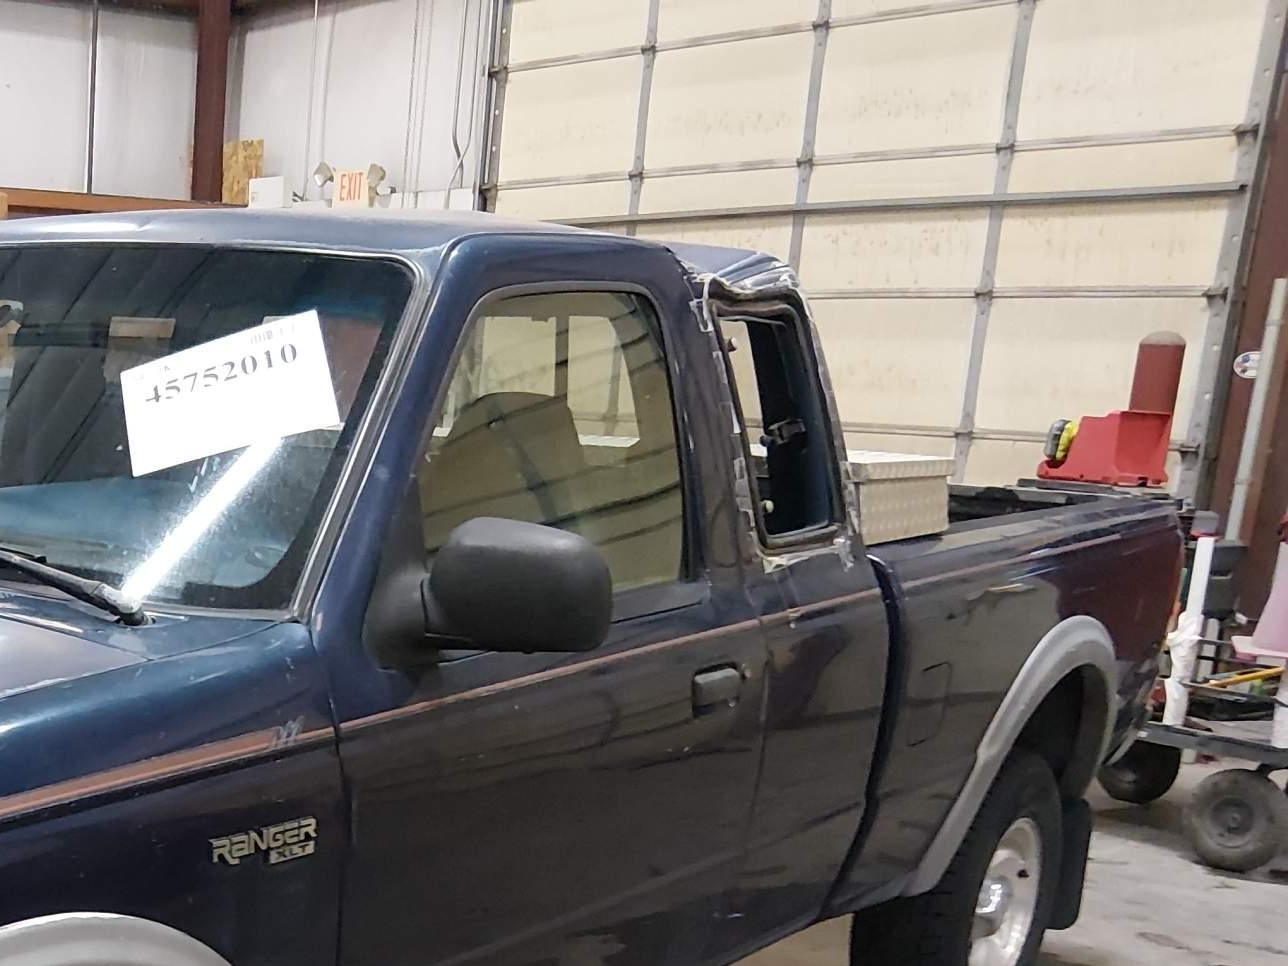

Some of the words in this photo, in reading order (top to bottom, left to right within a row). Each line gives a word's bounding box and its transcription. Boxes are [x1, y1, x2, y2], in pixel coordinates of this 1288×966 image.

[339, 171, 364, 202] EXIT
[145, 343, 298, 403] 45752010
[208, 817, 318, 865] RANGER
